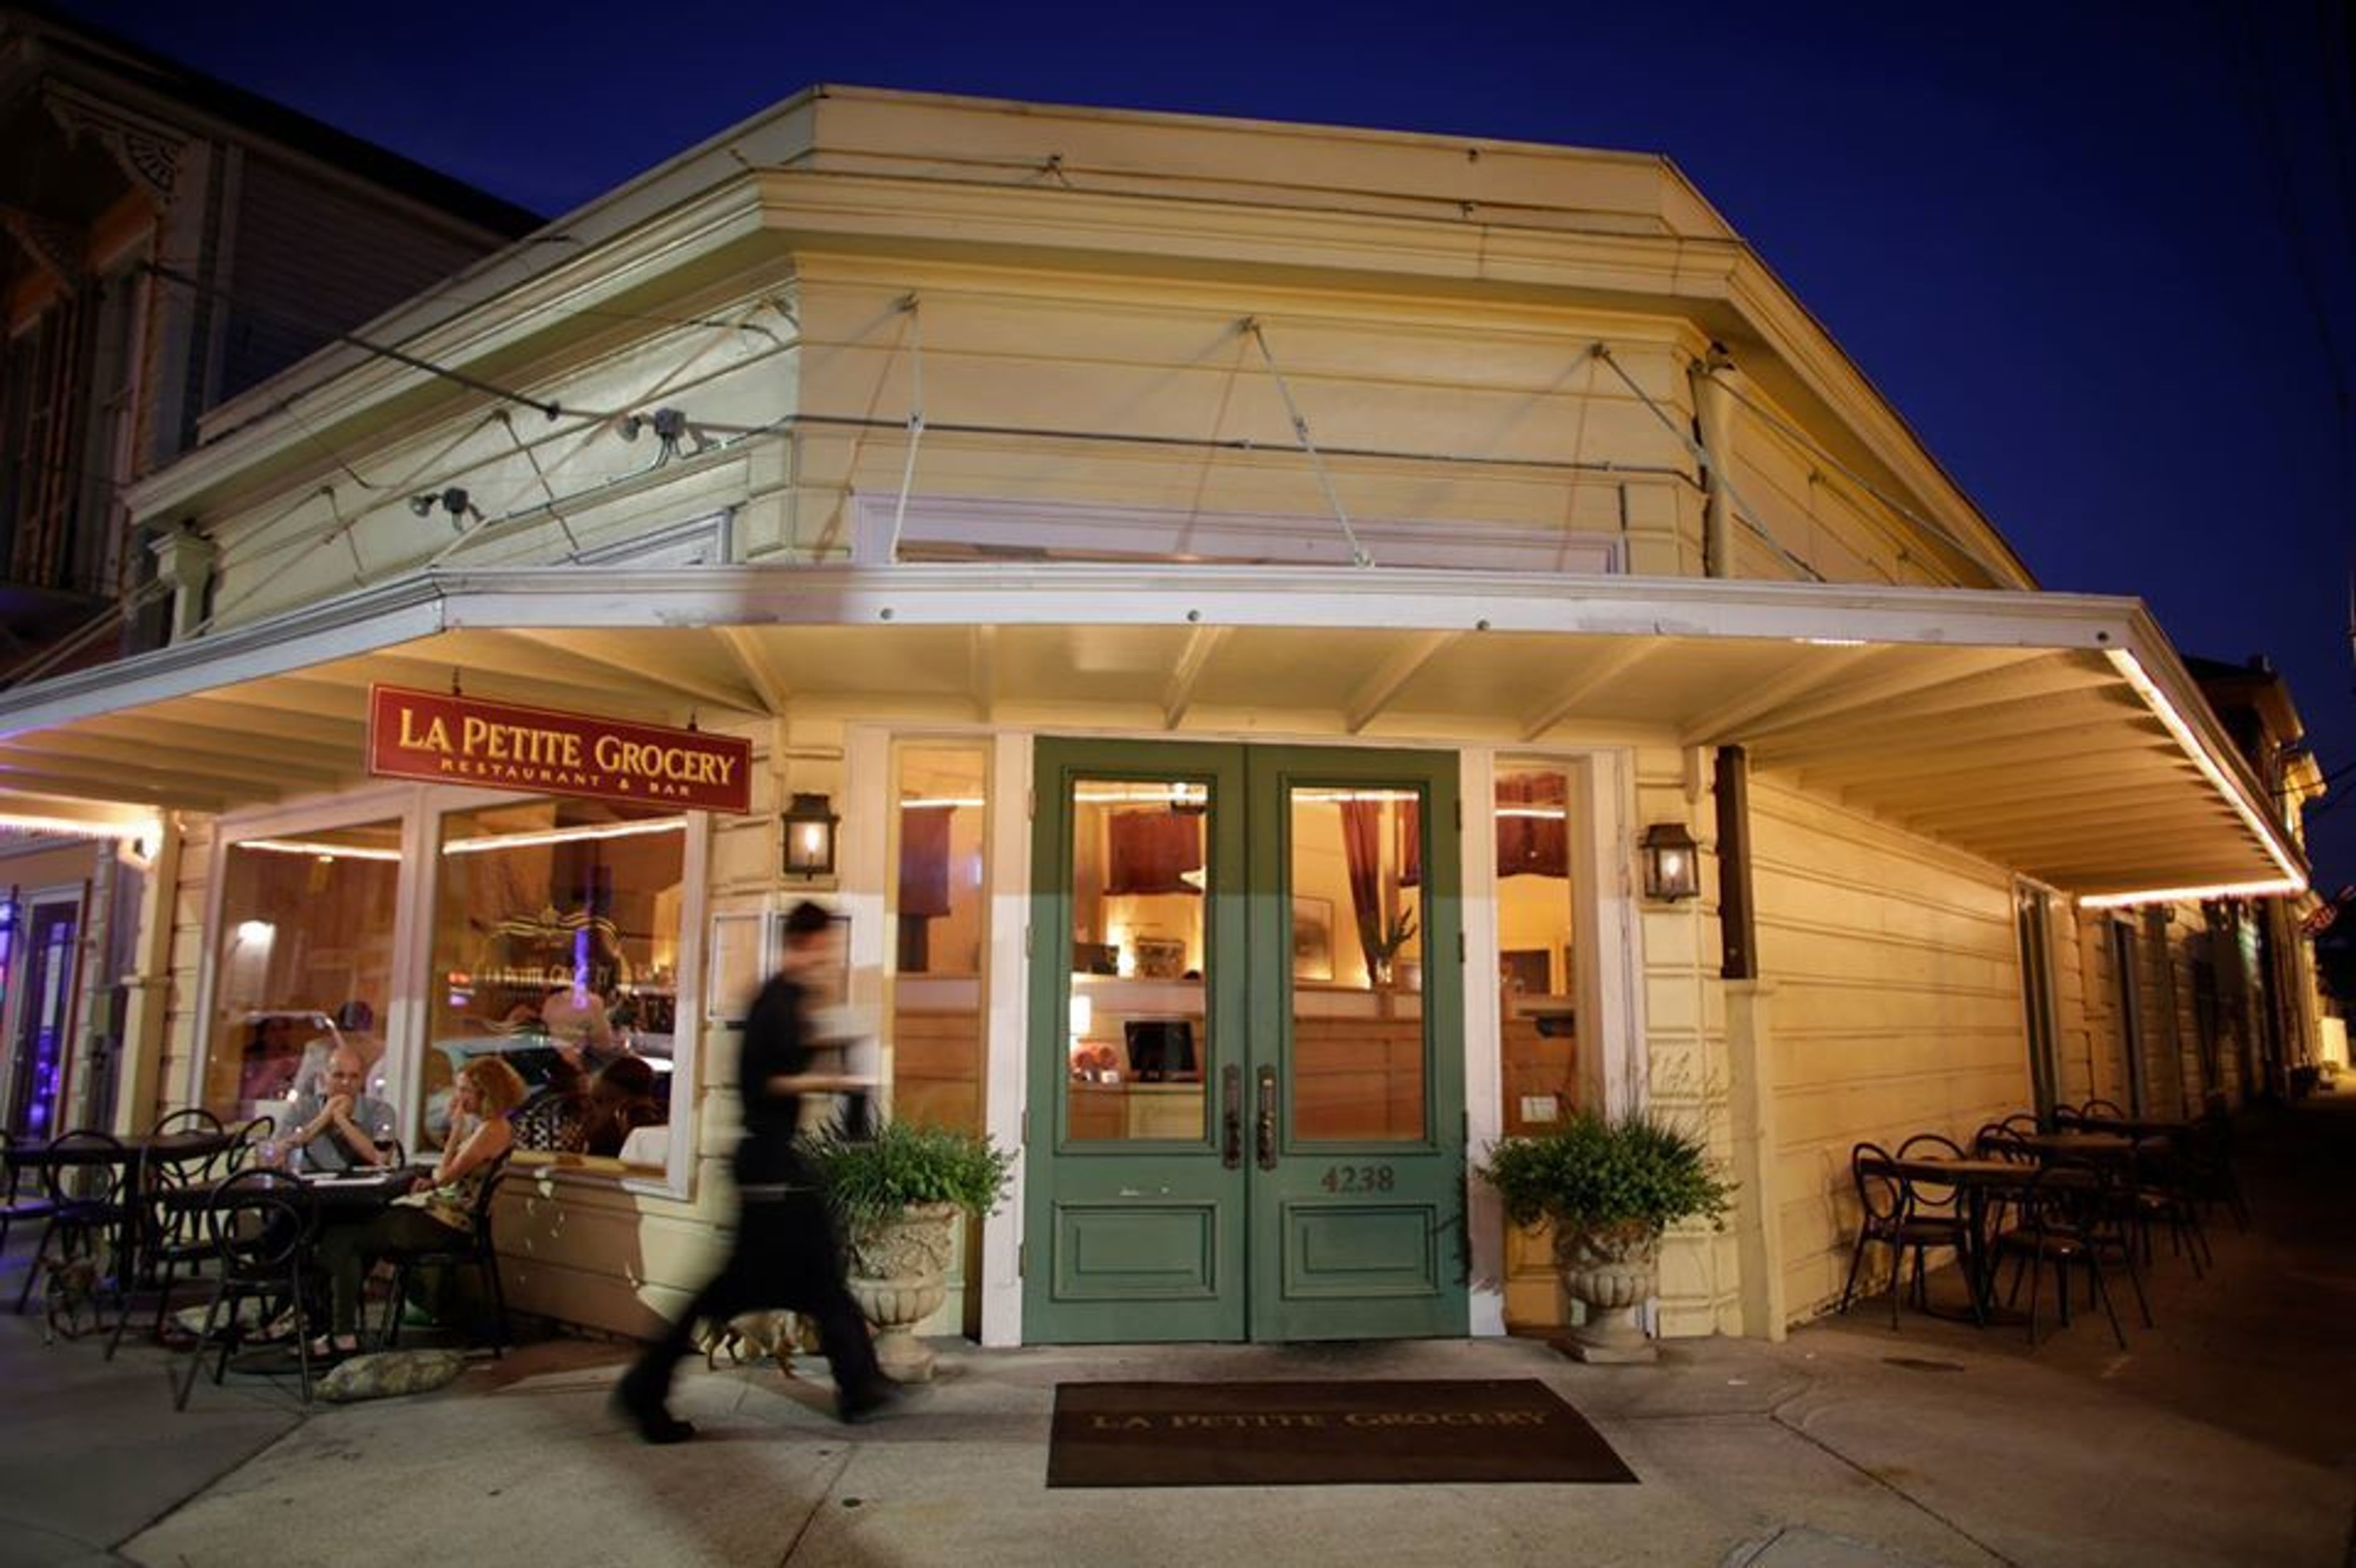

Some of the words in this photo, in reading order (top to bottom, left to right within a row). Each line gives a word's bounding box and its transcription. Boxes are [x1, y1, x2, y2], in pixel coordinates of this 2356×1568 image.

[399, 707, 453, 753] LA
[461, 716, 582, 769] PETITE
[595, 735, 736, 786] GROCERY
[441, 759, 601, 788] RESTAURANT
[618, 778, 630, 790] &
[649, 783, 690, 797] BAR
[1321, 1166, 1395, 1193] 4238
